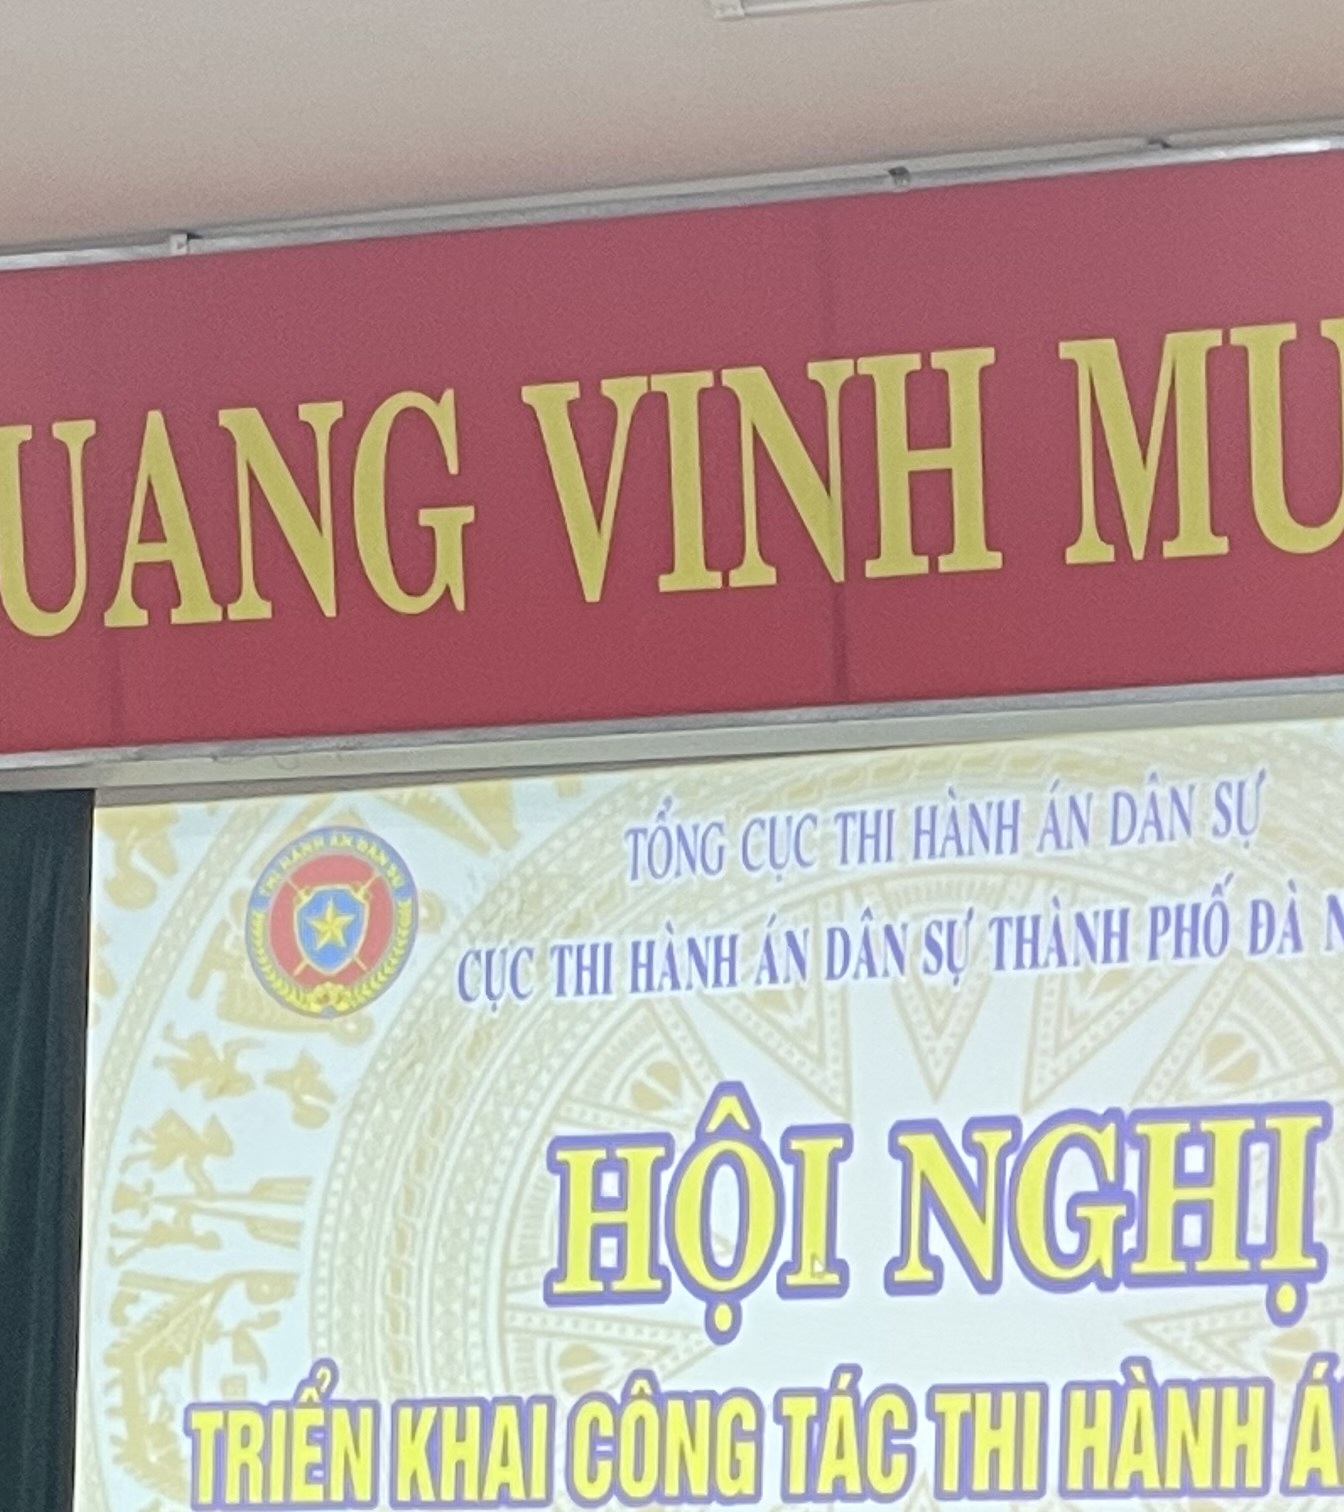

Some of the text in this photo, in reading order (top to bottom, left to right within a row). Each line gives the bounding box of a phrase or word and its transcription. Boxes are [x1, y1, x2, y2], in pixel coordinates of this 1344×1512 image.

[521, 346, 1002, 602] VINH
[625, 768, 1266, 882] TỔNG CỤC THI HÀNH ÁN DÂN SỰ
[457, 947, 534, 1012] CỤC
[551, 942, 612, 997] THI
[630, 920, 739, 993] HÀNH
[757, 913, 809, 985] ÁN
[825, 907, 907, 982] DÂN
[923, 907, 974, 986] SỰ
[989, 895, 1130, 971] THÀNH
[1147, 872, 1235, 961] PHỐ
[1247, 879, 1304, 956] ĐÀ
[543, 1080, 1333, 1345] HỘI NGHỊ
[185, 1357, 380, 1511] TRIỂN
[389, 1395, 556, 1509] KHAI
[566, 1369, 765, 1509] CÔNG
[777, 1362, 917, 1503] TÁC
[933, 1379, 1048, 1501] THI
[1061, 1355, 1274, 1498] HÀNH
